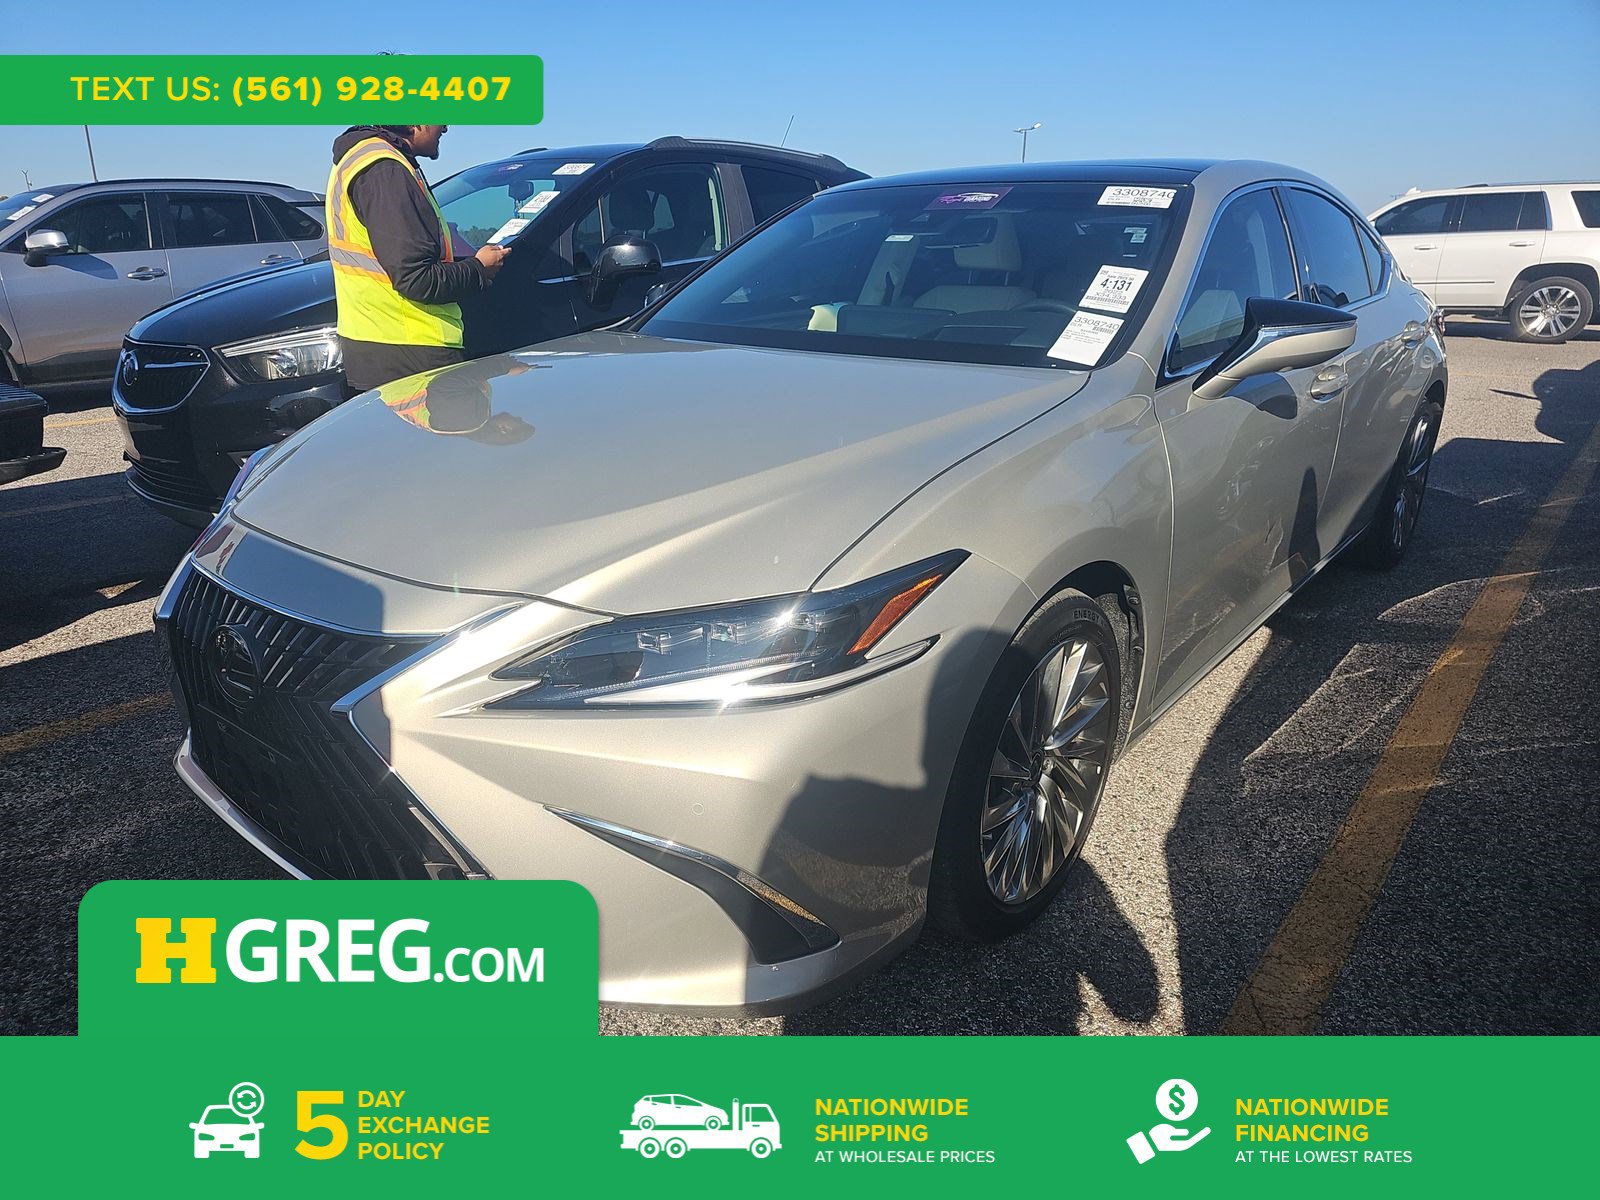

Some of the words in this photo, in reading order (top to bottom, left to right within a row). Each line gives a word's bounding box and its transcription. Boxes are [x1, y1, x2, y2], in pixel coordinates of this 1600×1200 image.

[1100, 278, 1133, 292] 4:131
[1074, 316, 1120, 330] 3308740
[1073, 609, 1100, 623] ENERGY
